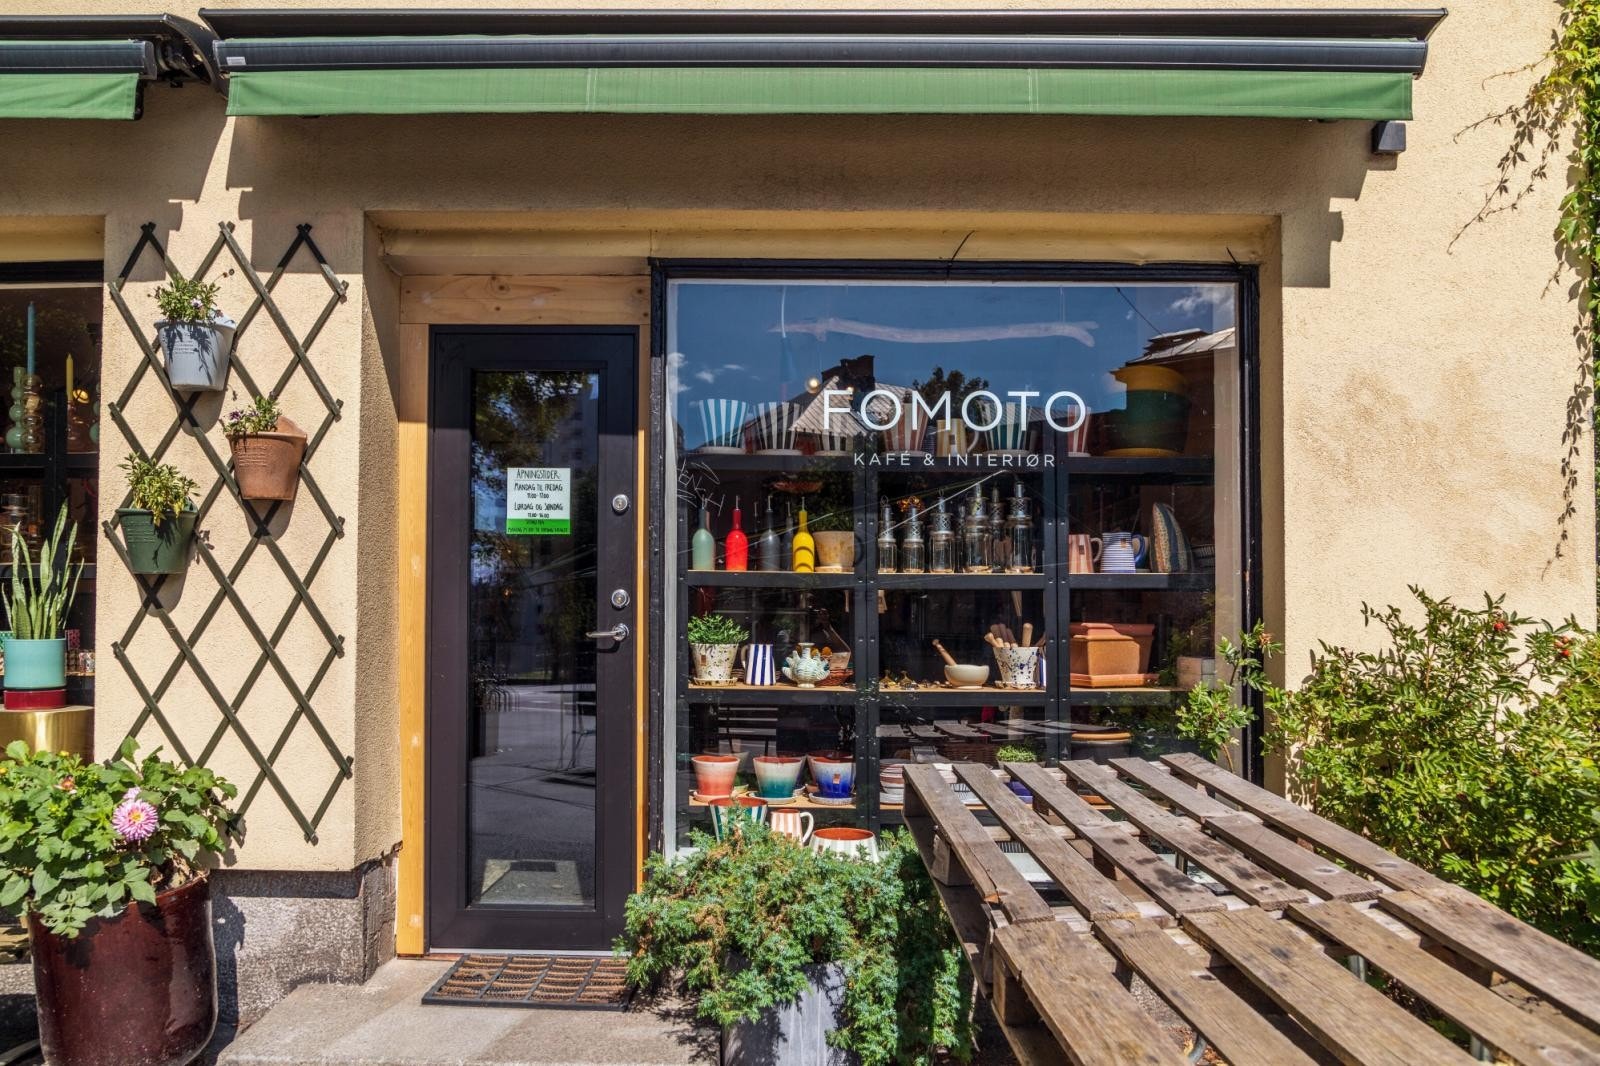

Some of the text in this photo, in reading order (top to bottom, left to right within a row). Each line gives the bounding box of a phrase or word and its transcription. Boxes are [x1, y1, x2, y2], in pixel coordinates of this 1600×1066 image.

[823, 389, 1087, 433] FOMOTO
[853, 451, 1056, 468] KAFÉ & INTERIØR
